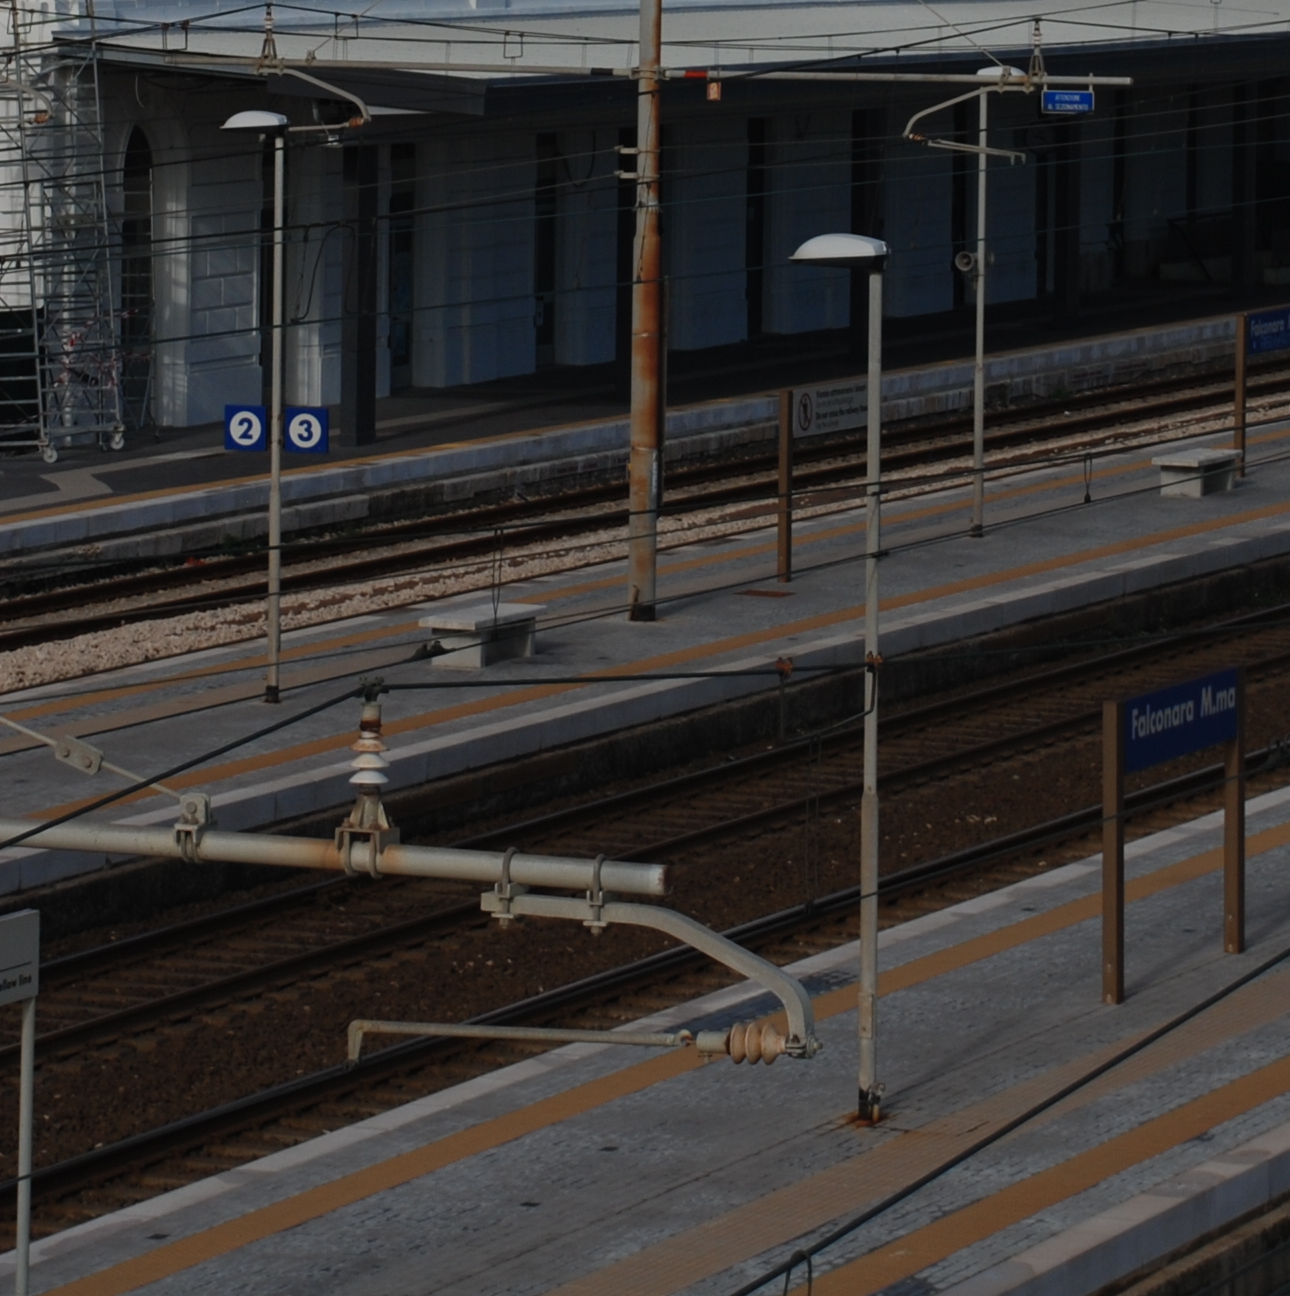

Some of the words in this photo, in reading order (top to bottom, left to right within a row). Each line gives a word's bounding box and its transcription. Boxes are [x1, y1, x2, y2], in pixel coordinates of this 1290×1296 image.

[238, 417, 253, 440] 2
[297, 419, 313, 442] 3
[1132, 700, 1195, 740] Falconara
[1200, 685, 1236, 718] M.ma
[19, 973, 32, 986] line
